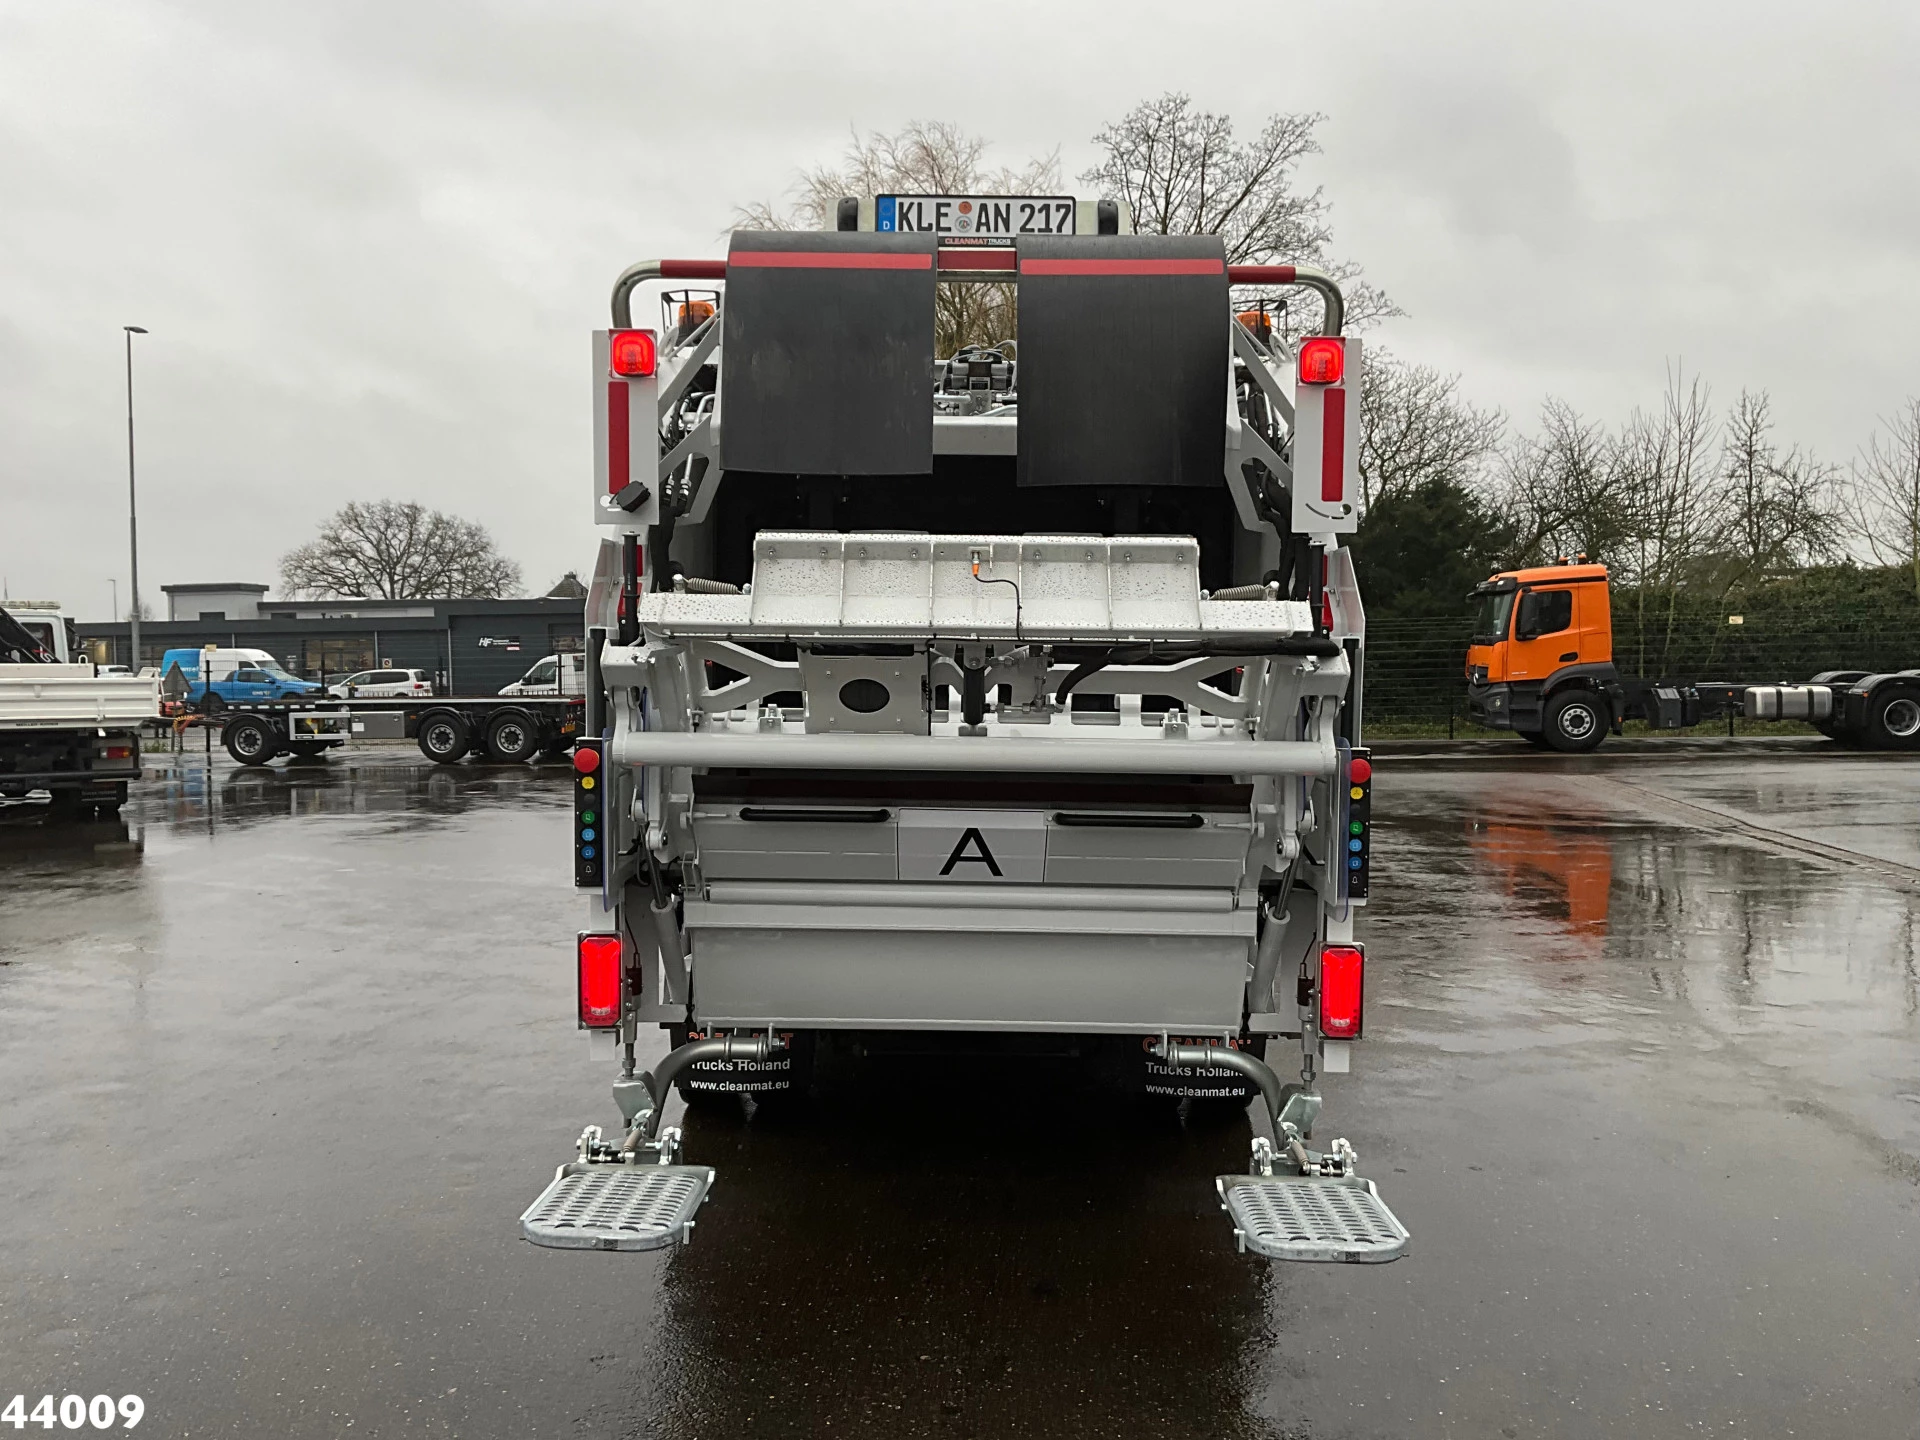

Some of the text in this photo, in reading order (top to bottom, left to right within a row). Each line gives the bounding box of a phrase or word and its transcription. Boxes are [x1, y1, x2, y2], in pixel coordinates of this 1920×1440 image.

[883, 202, 1072, 234] D KLE AN 217
[944, 237, 988, 245] CLEANMAT
[938, 827, 1004, 877] A
[691, 1059, 733, 1071] rucks
[1145, 1062, 1244, 1077] Trucks Hollan
[690, 1080, 790, 1092] www.cleanmat.eu
[1145, 1084, 1246, 1097] www.cleanmat.eu
